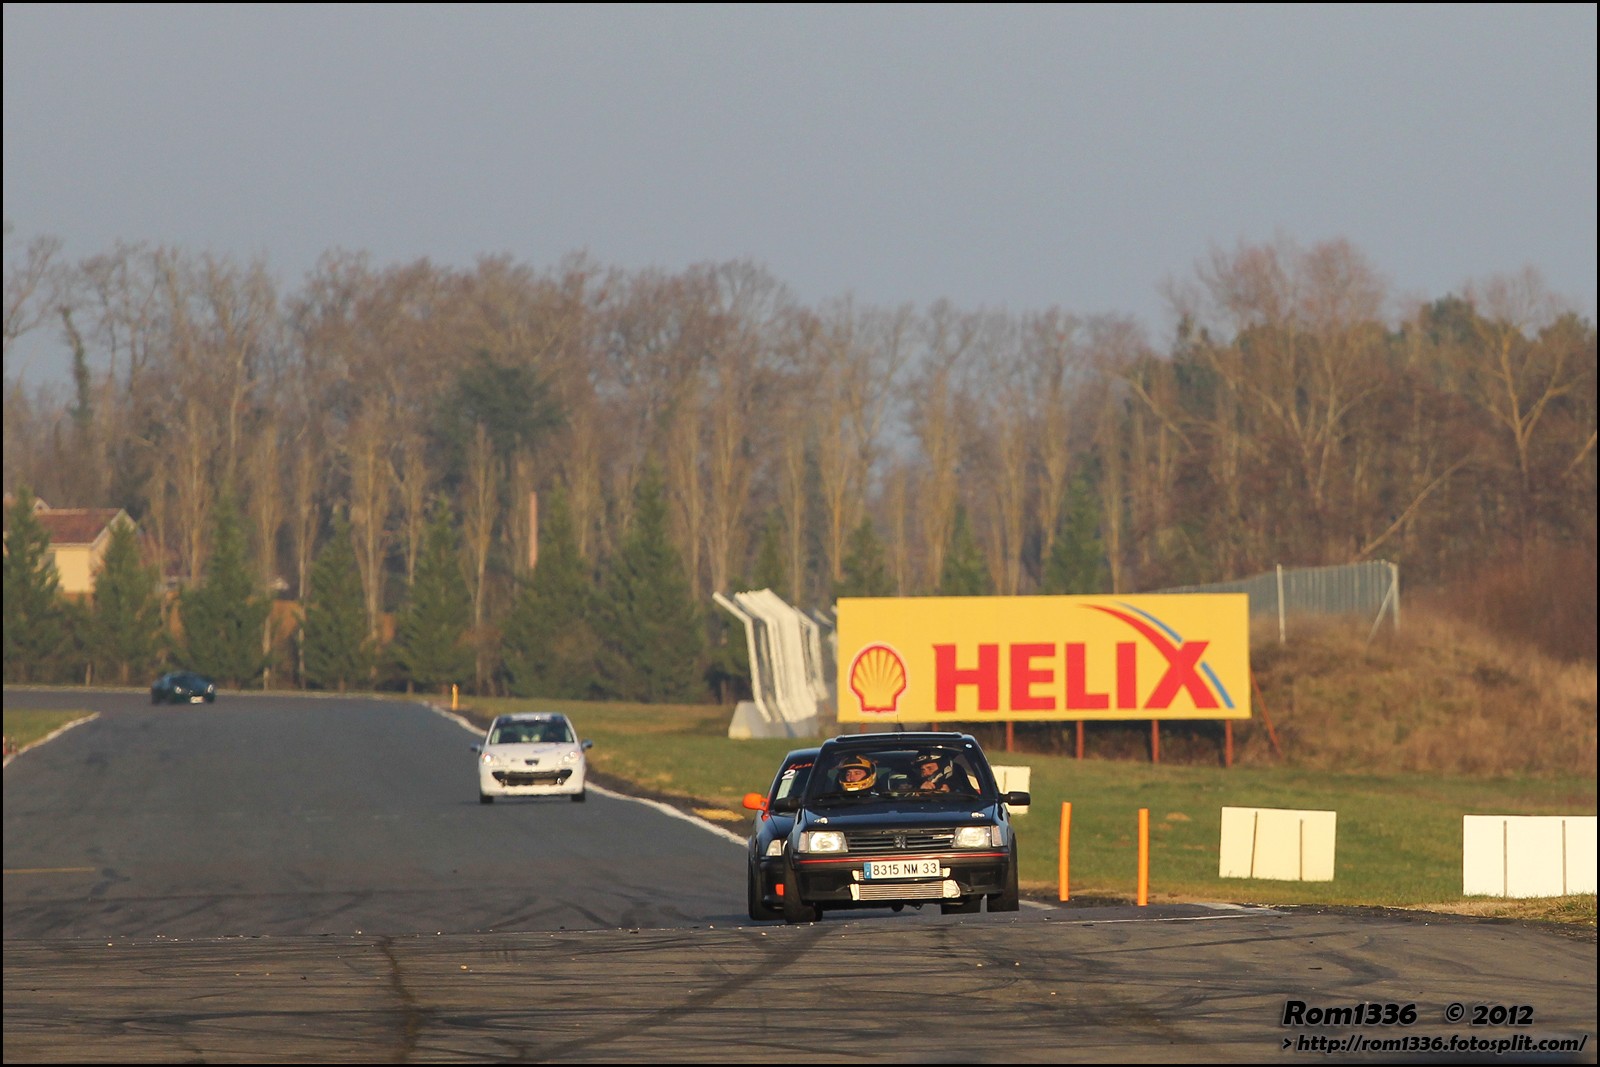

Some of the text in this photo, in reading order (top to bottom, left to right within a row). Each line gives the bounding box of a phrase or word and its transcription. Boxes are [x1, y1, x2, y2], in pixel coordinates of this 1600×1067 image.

[932, 640, 1220, 712] HELIX
[781, 769, 796, 779] 2
[873, 862, 937, 876] 8315 NM 33
